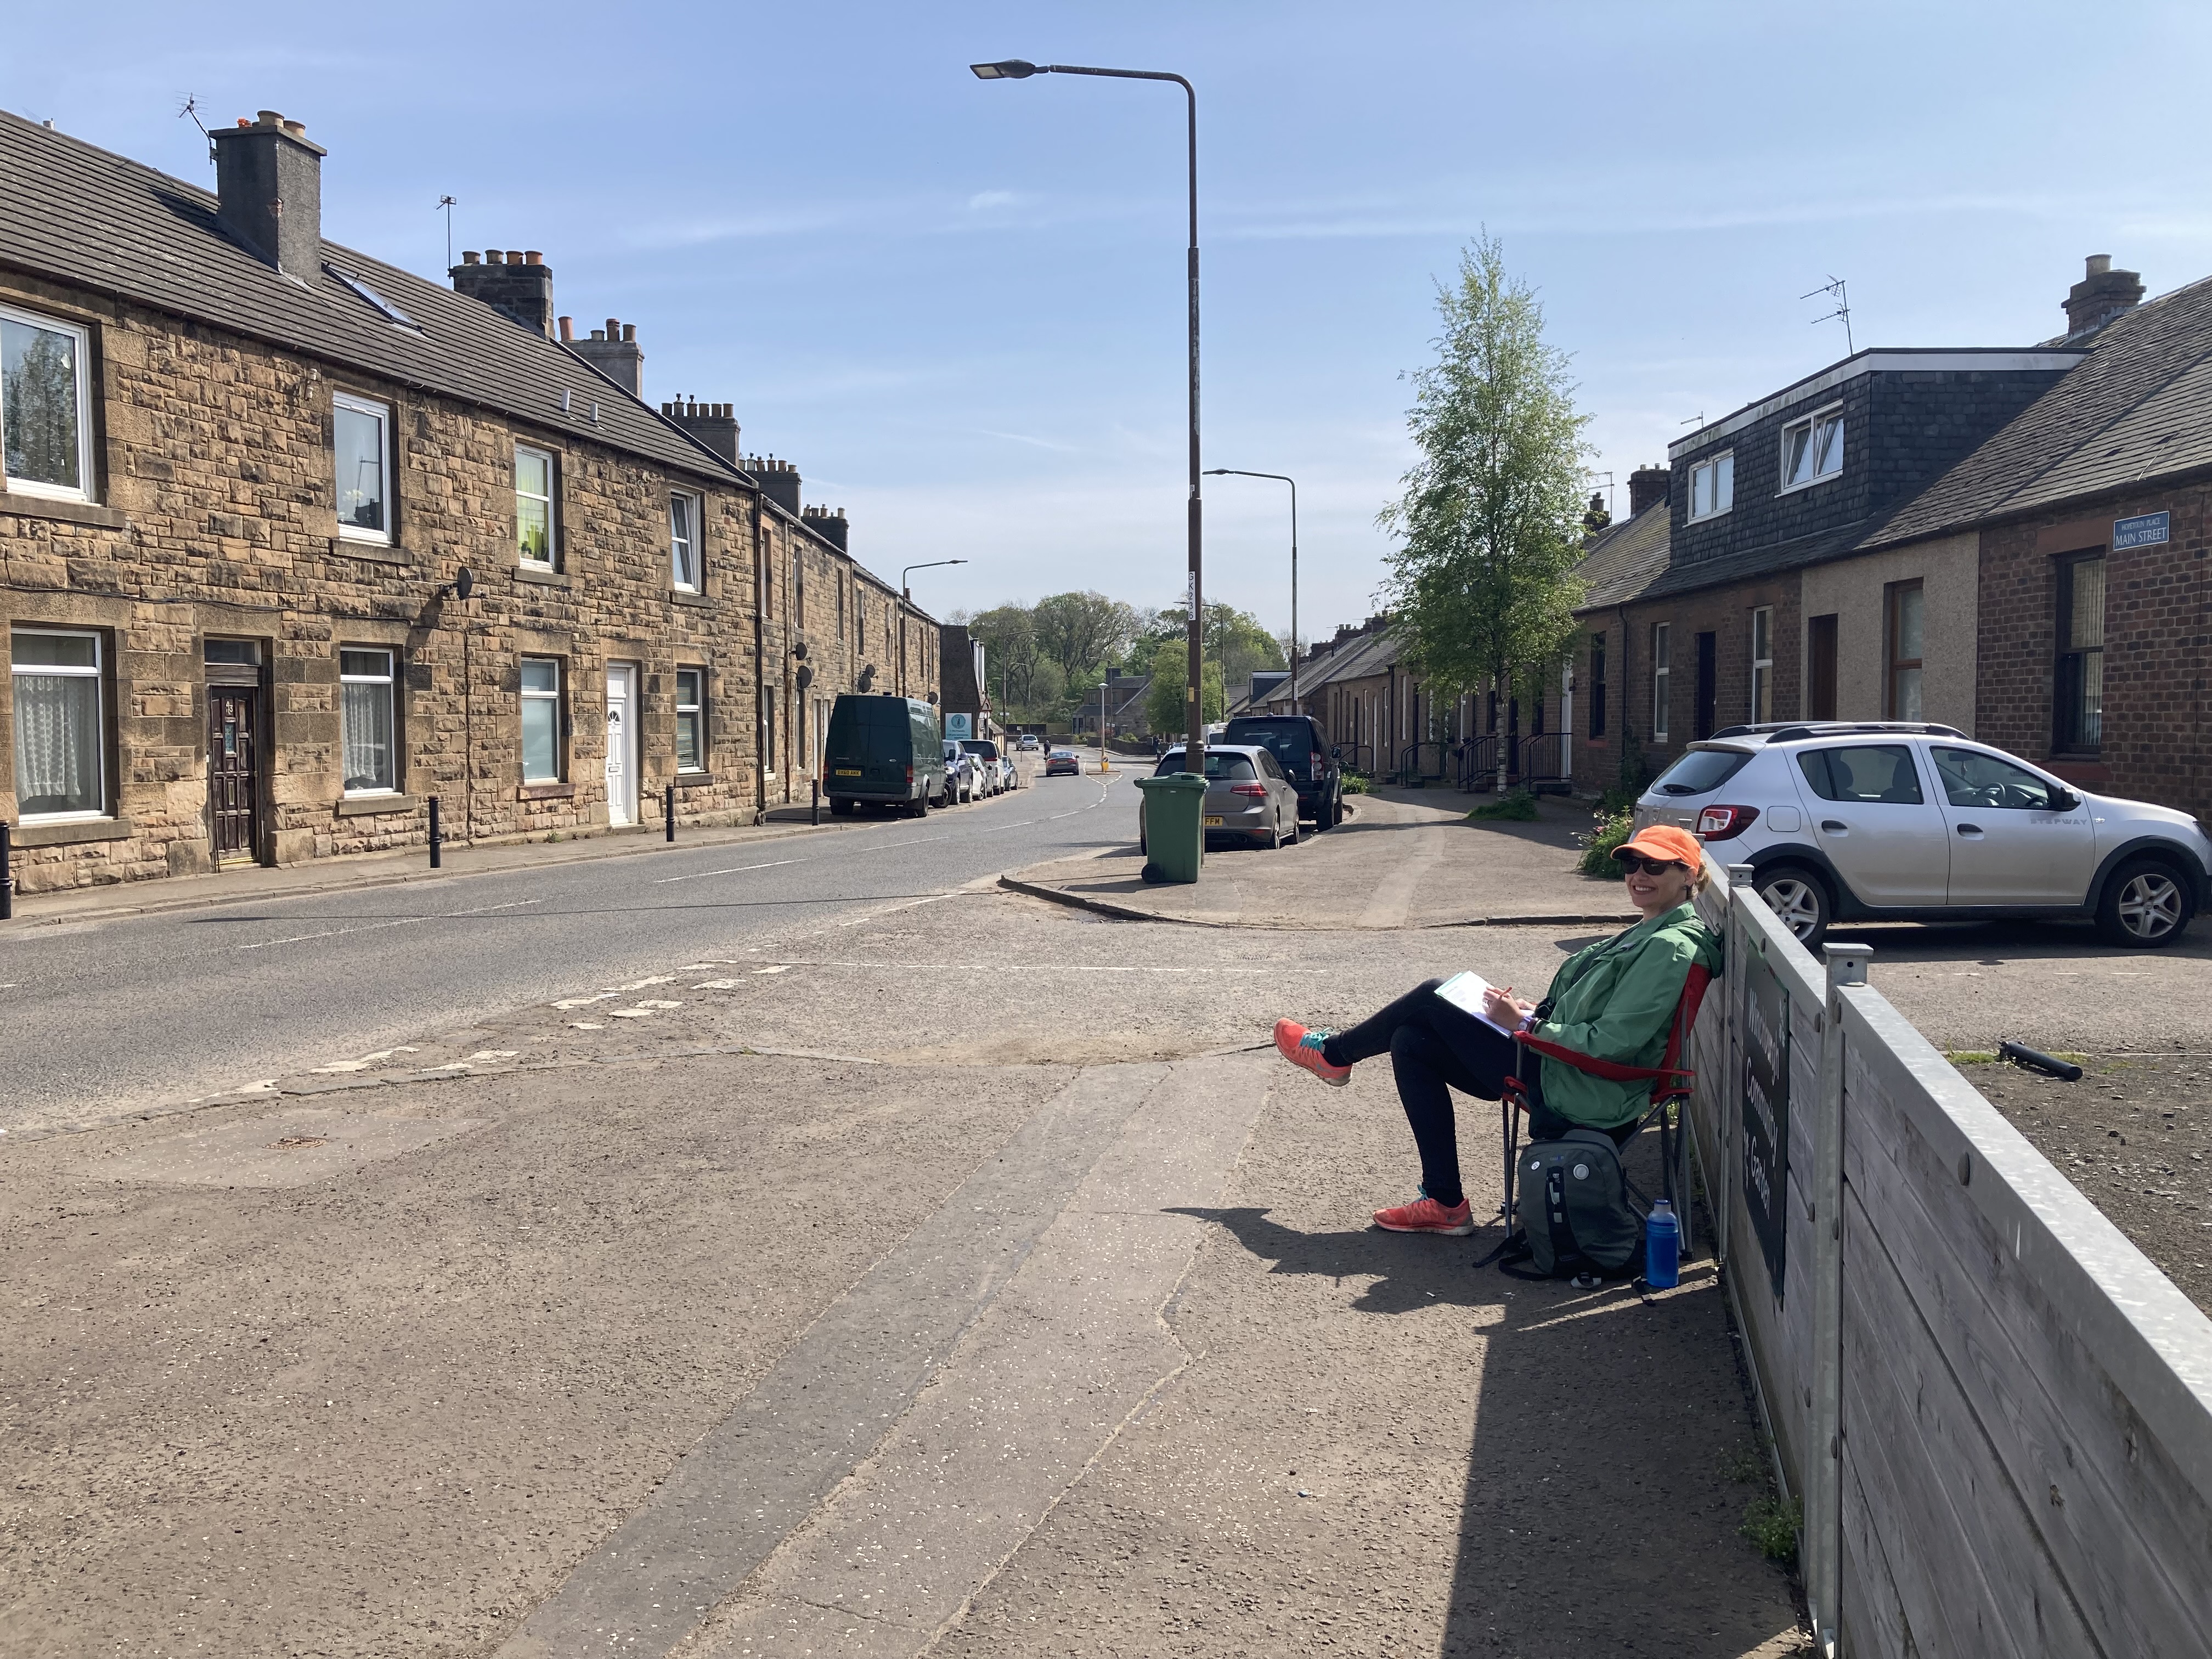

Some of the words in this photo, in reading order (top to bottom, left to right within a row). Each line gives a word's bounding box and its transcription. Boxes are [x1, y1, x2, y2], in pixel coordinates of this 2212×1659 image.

[2115, 532, 2136, 546] MAIN
[2138, 527, 2166, 543] STREET
[2146, 517, 2160, 527] PLACE
[1746, 1056, 1778, 1169] Community
[1751, 1135, 1770, 1220] Garden
